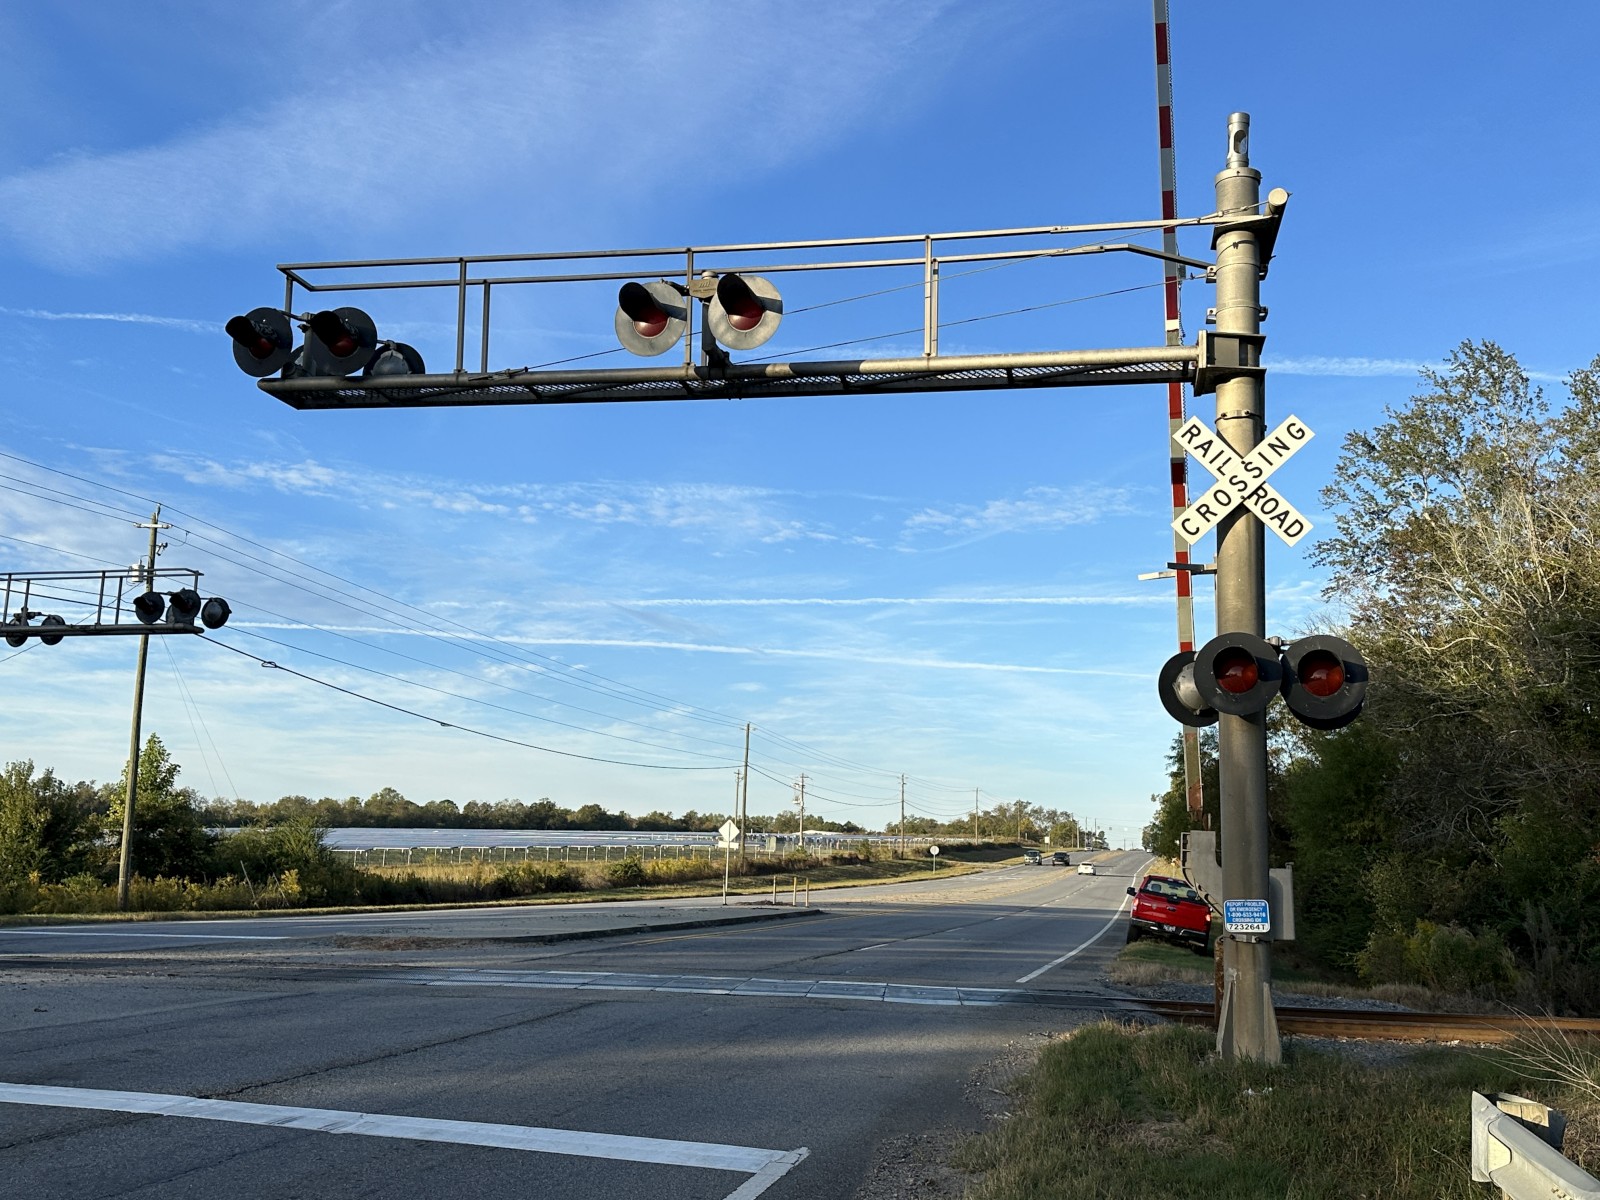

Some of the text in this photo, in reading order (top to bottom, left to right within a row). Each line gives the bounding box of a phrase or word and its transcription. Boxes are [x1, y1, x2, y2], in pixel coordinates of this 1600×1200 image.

[1180, 423, 1304, 538] RAIL ROAD
[1181, 422, 1306, 536] CROSSING
